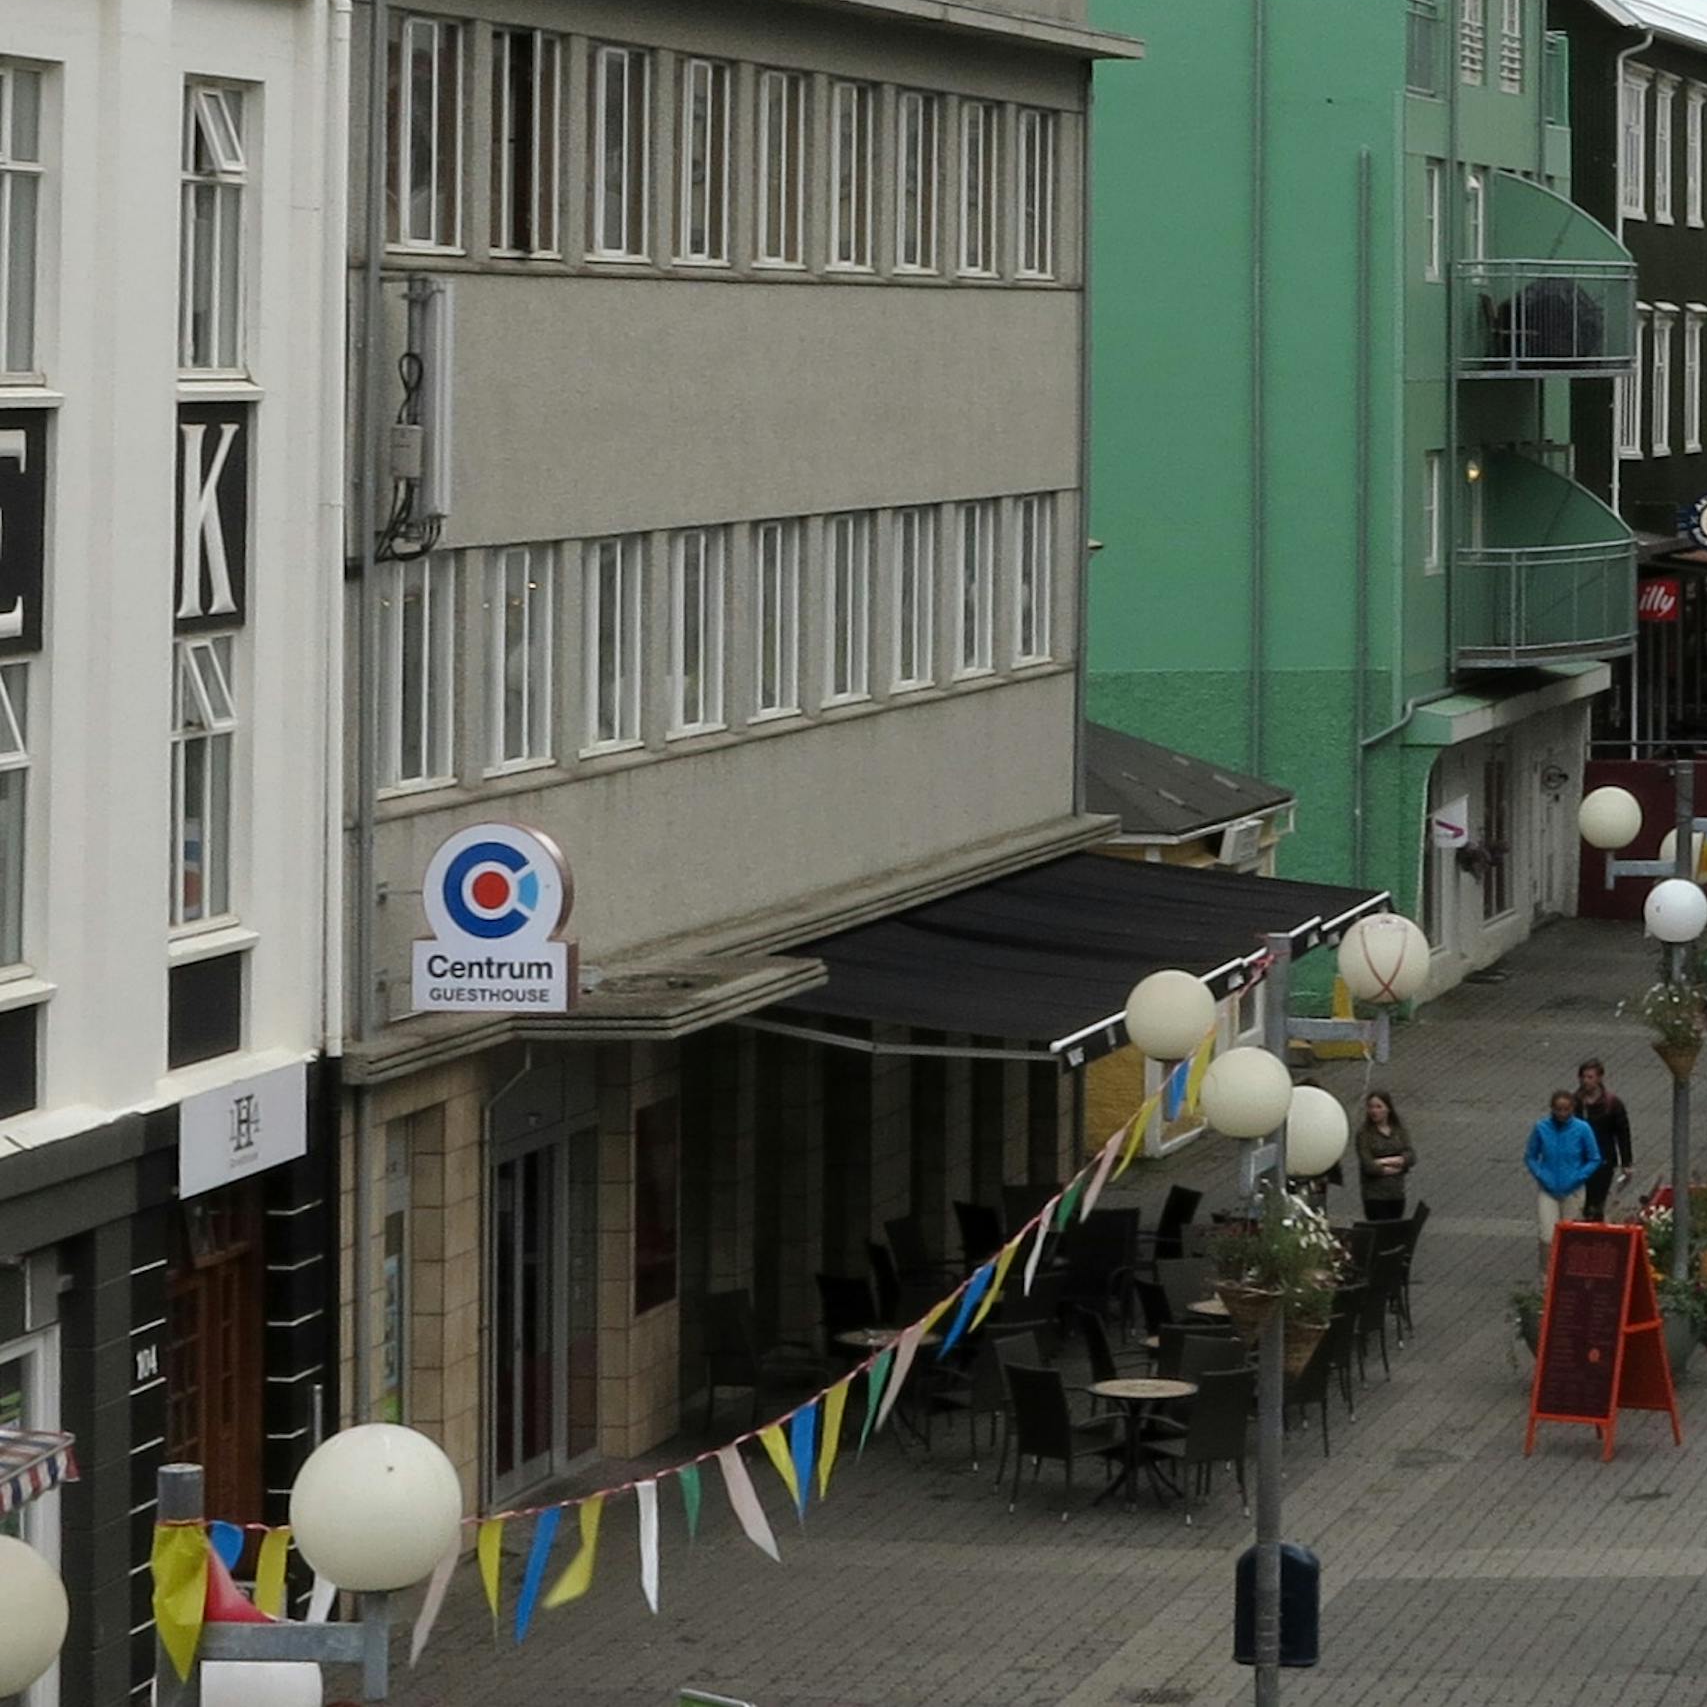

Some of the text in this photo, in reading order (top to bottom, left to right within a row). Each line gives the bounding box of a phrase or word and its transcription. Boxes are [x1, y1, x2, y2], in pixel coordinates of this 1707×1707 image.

[1640, 585, 1676, 617] illy
[427, 954, 553, 980] Centrum
[429, 987, 550, 1003] GUESTHOUSE
